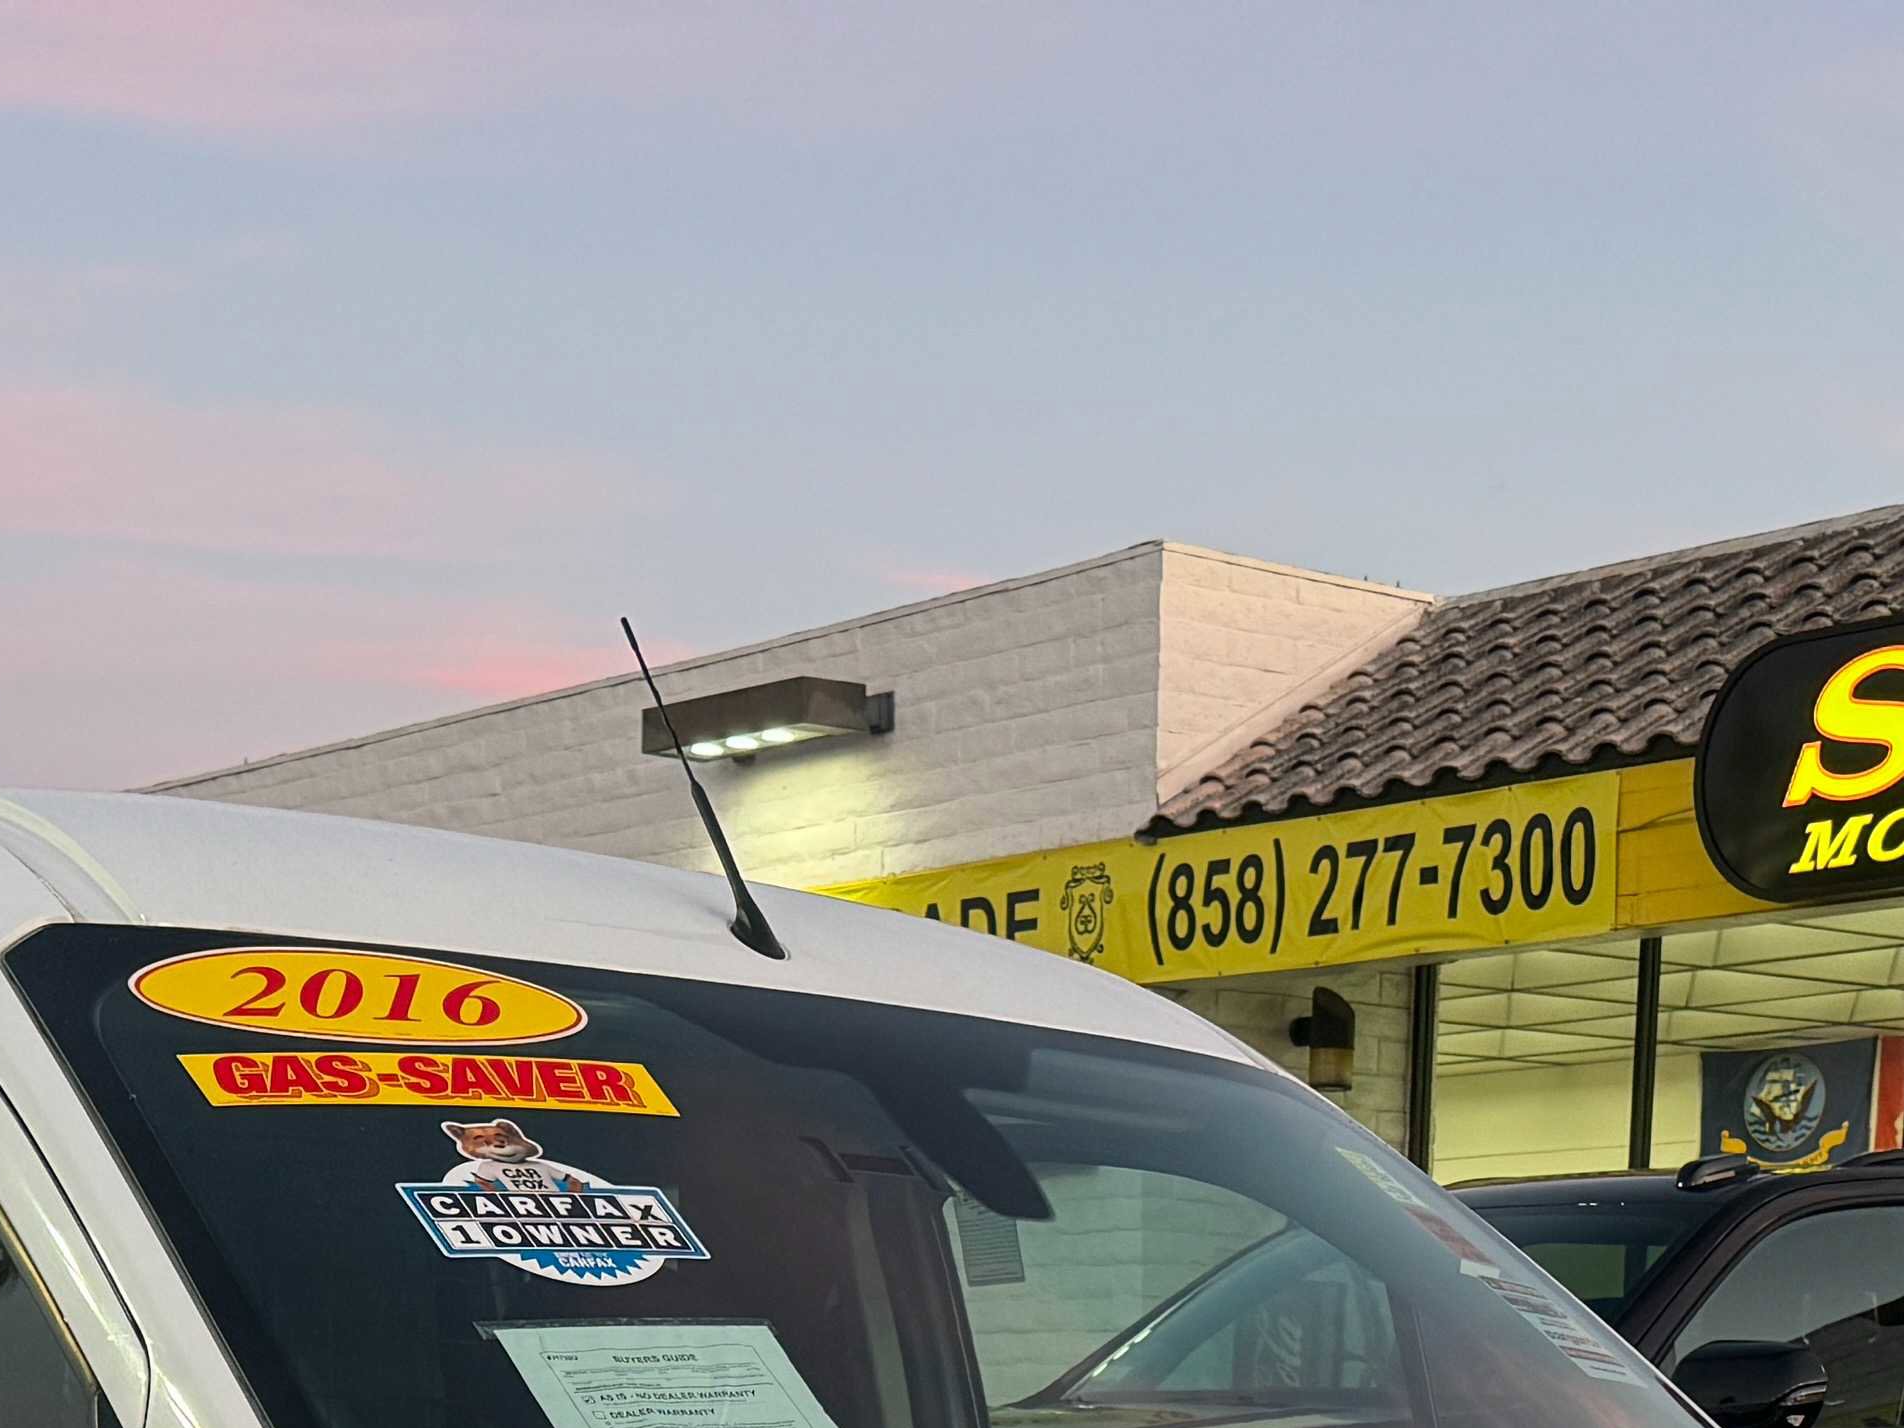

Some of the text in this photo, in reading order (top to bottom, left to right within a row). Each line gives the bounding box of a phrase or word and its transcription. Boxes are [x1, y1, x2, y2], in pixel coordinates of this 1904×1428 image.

[1147, 838, 1286, 966] (858)
[1307, 806, 1597, 937] 277-7300
[224, 966, 502, 1026] 2016
[213, 1055, 642, 1107] GAS-SAVER
[501, 1167, 542, 1180] CAR
[511, 1178, 549, 1190] FOX
[429, 1196, 663, 1222] CARFAX
[652, 1390, 697, 1400] DEALER
[696, 1388, 757, 1399] WARRANTY
[609, 1408, 656, 1420] DEALER
